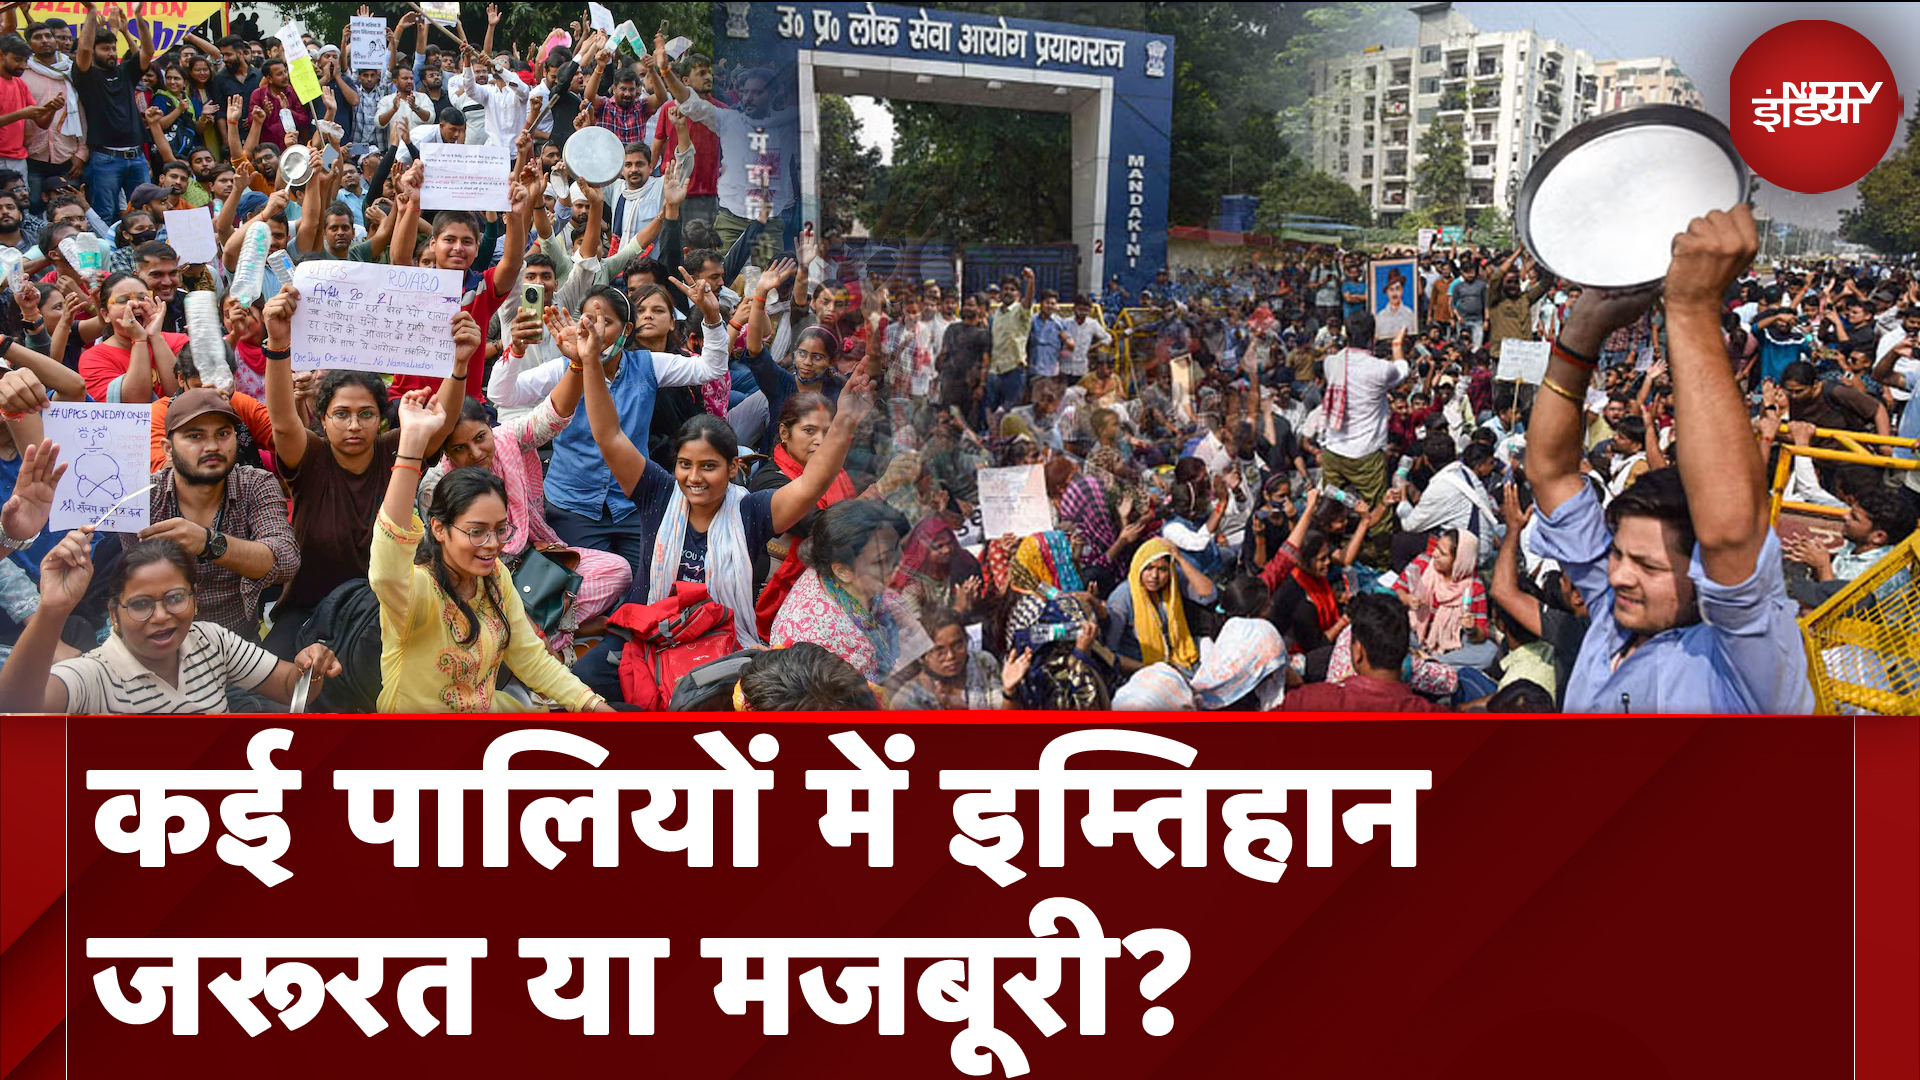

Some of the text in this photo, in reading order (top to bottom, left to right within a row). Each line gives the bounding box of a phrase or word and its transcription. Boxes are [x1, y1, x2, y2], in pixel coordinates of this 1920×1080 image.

[776, 2, 1126, 68] उ० प्र० लोक सेवा आयोग प्रयागराज
[1127, 155, 1145, 268] MANDAKINI
[1095, 239, 1103, 254] 2
[310, 263, 348, 280] UPPCS
[387, 269, 440, 292] RO/ARO
